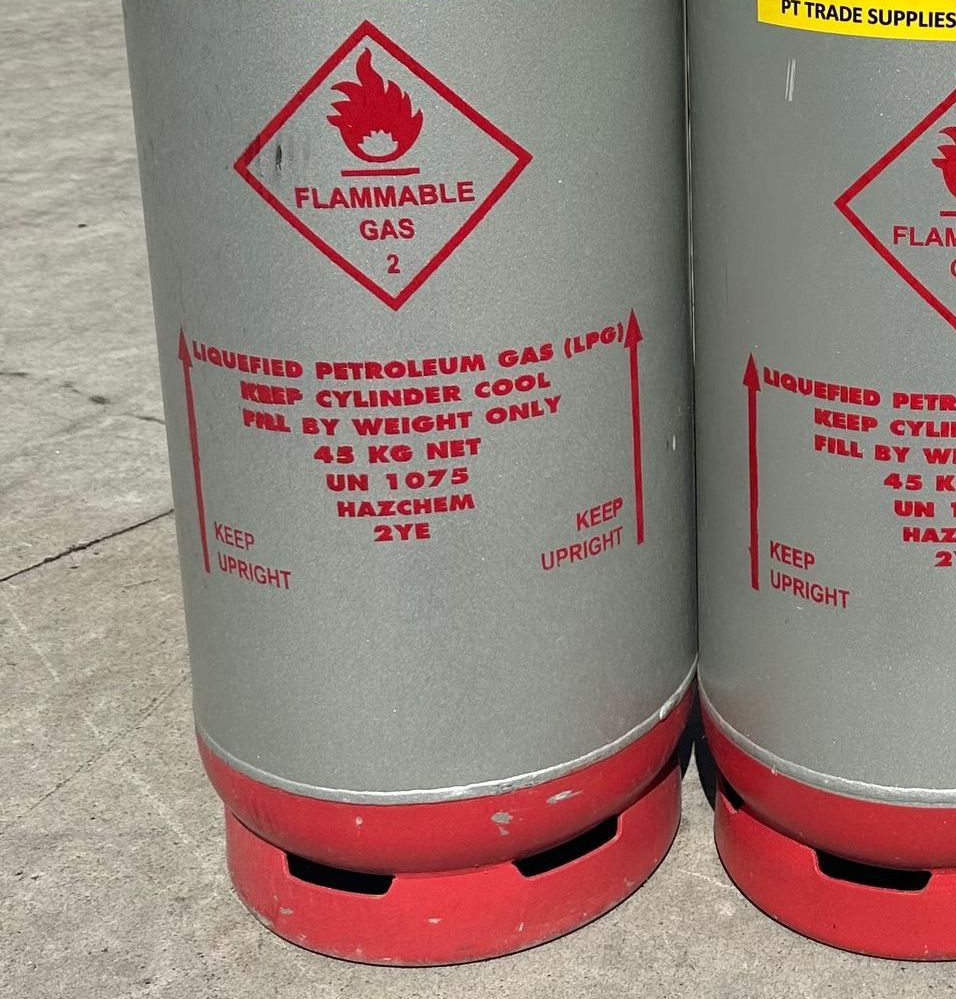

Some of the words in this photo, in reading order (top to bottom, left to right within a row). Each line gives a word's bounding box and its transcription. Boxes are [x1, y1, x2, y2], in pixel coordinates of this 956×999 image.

[804, 0, 862, 23] TRADE
[295, 181, 475, 208] FLAMMABLE
[360, 219, 416, 241] GAS
[386, 254, 401, 274] 2
[192, 340, 303, 377] LIQUEFIED
[316, 354, 485, 381] PETROLEUM
[498, 343, 553, 367] GAS
[563, 322, 624, 360] (LPG)
[240, 381, 303, 405] KEEP
[316, 385, 461, 409] CYLINDER
[475, 372, 551, 398] COOL
[763, 366, 881, 407] LIQUEFIED
[302, 417, 338, 436] BY
[351, 411, 473, 436] WEIGHT
[485, 396, 562, 425] ONLY
[814, 408, 878, 433] KEEP
[313, 443, 355, 464] 45
[368, 444, 414, 464] KG
[426, 438, 482, 461] NET
[814, 434, 863, 459] FILL
[874, 444, 911, 464] BY
[326, 473, 369, 492] UN
[386, 467, 470, 490] 1075
[883, 472, 923, 491] 45
[337, 494, 475, 518] HAZCHEM
[576, 497, 624, 532] KEEP
[893, 500, 935, 519] UN
[214, 520, 255, 552] KEEP
[373, 523, 431, 543] 2YE
[540, 526, 624, 572] UPRIGHT
[769, 540, 816, 571] KEEP
[217, 551, 291, 590] UPRIGHT
[770, 569, 850, 609] UPRIGHT
